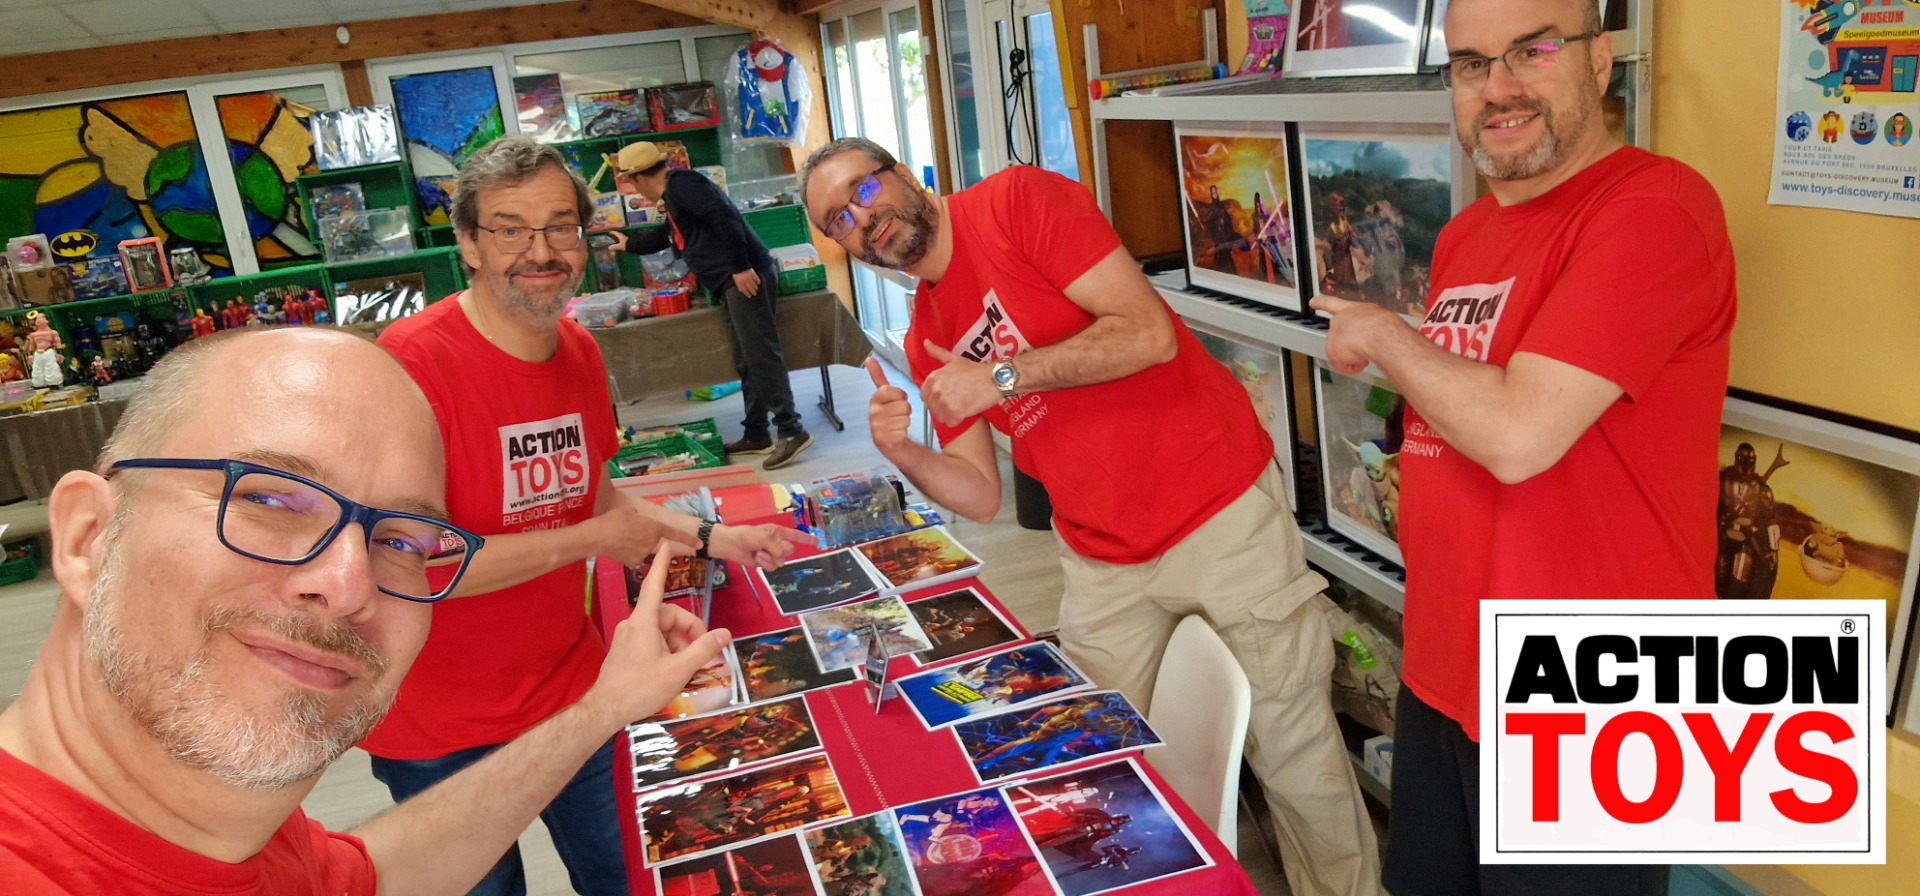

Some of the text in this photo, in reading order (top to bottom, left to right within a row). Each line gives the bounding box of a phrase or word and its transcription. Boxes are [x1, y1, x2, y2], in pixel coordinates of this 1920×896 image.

[1861, 10, 1904, 24] MUSEUM
[1844, 29, 1920, 40] Speelgoedmuseum
[508, 424, 581, 461] ACTION
[510, 449, 584, 498] TOYS
